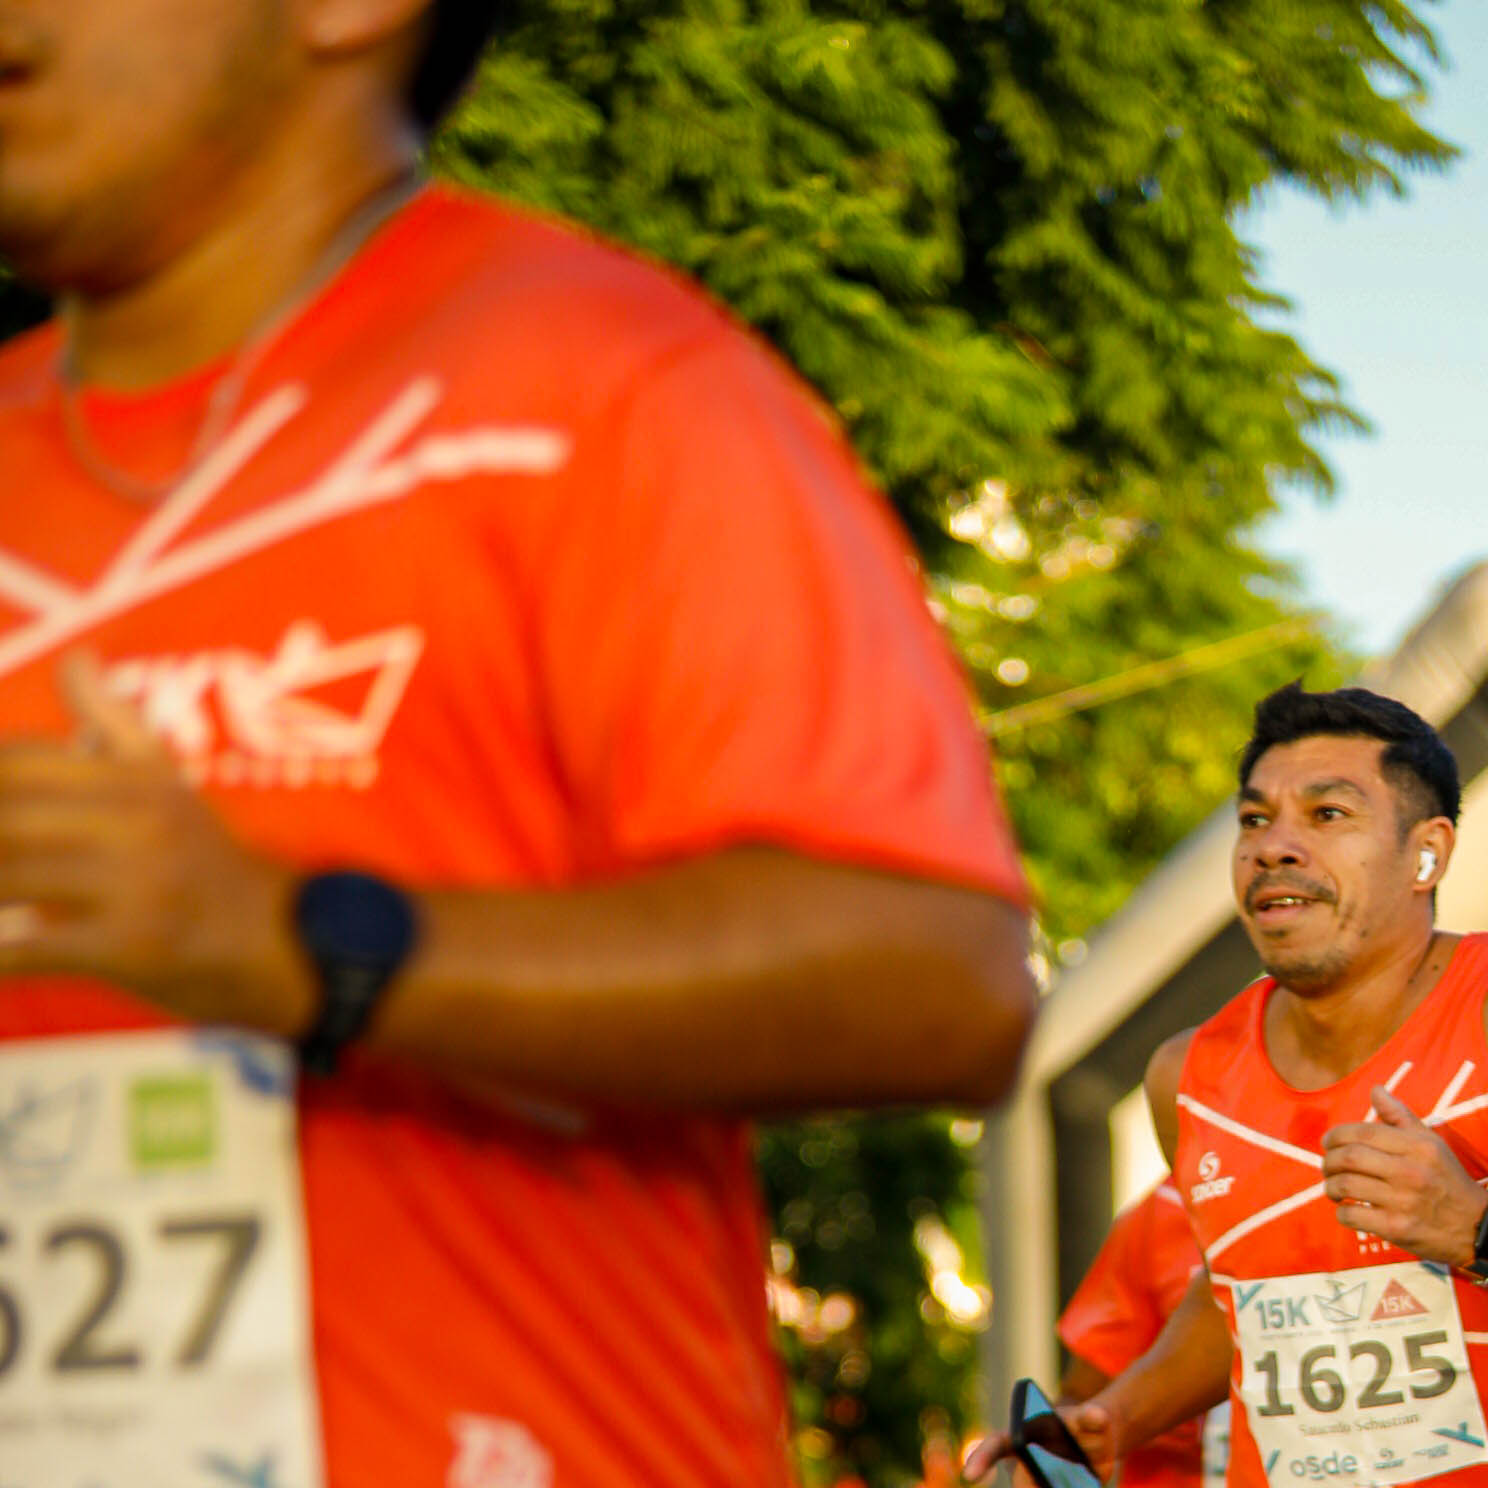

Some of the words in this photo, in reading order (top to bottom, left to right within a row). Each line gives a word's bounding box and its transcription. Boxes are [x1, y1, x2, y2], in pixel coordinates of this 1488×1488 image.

[0, 1214, 261, 1372] 27
[1381, 1294, 1416, 1313] 15K
[1254, 1297, 1310, 1330] 15K
[1254, 1329, 1457, 1417] 1625
[1289, 1451, 1358, 1480] osde
